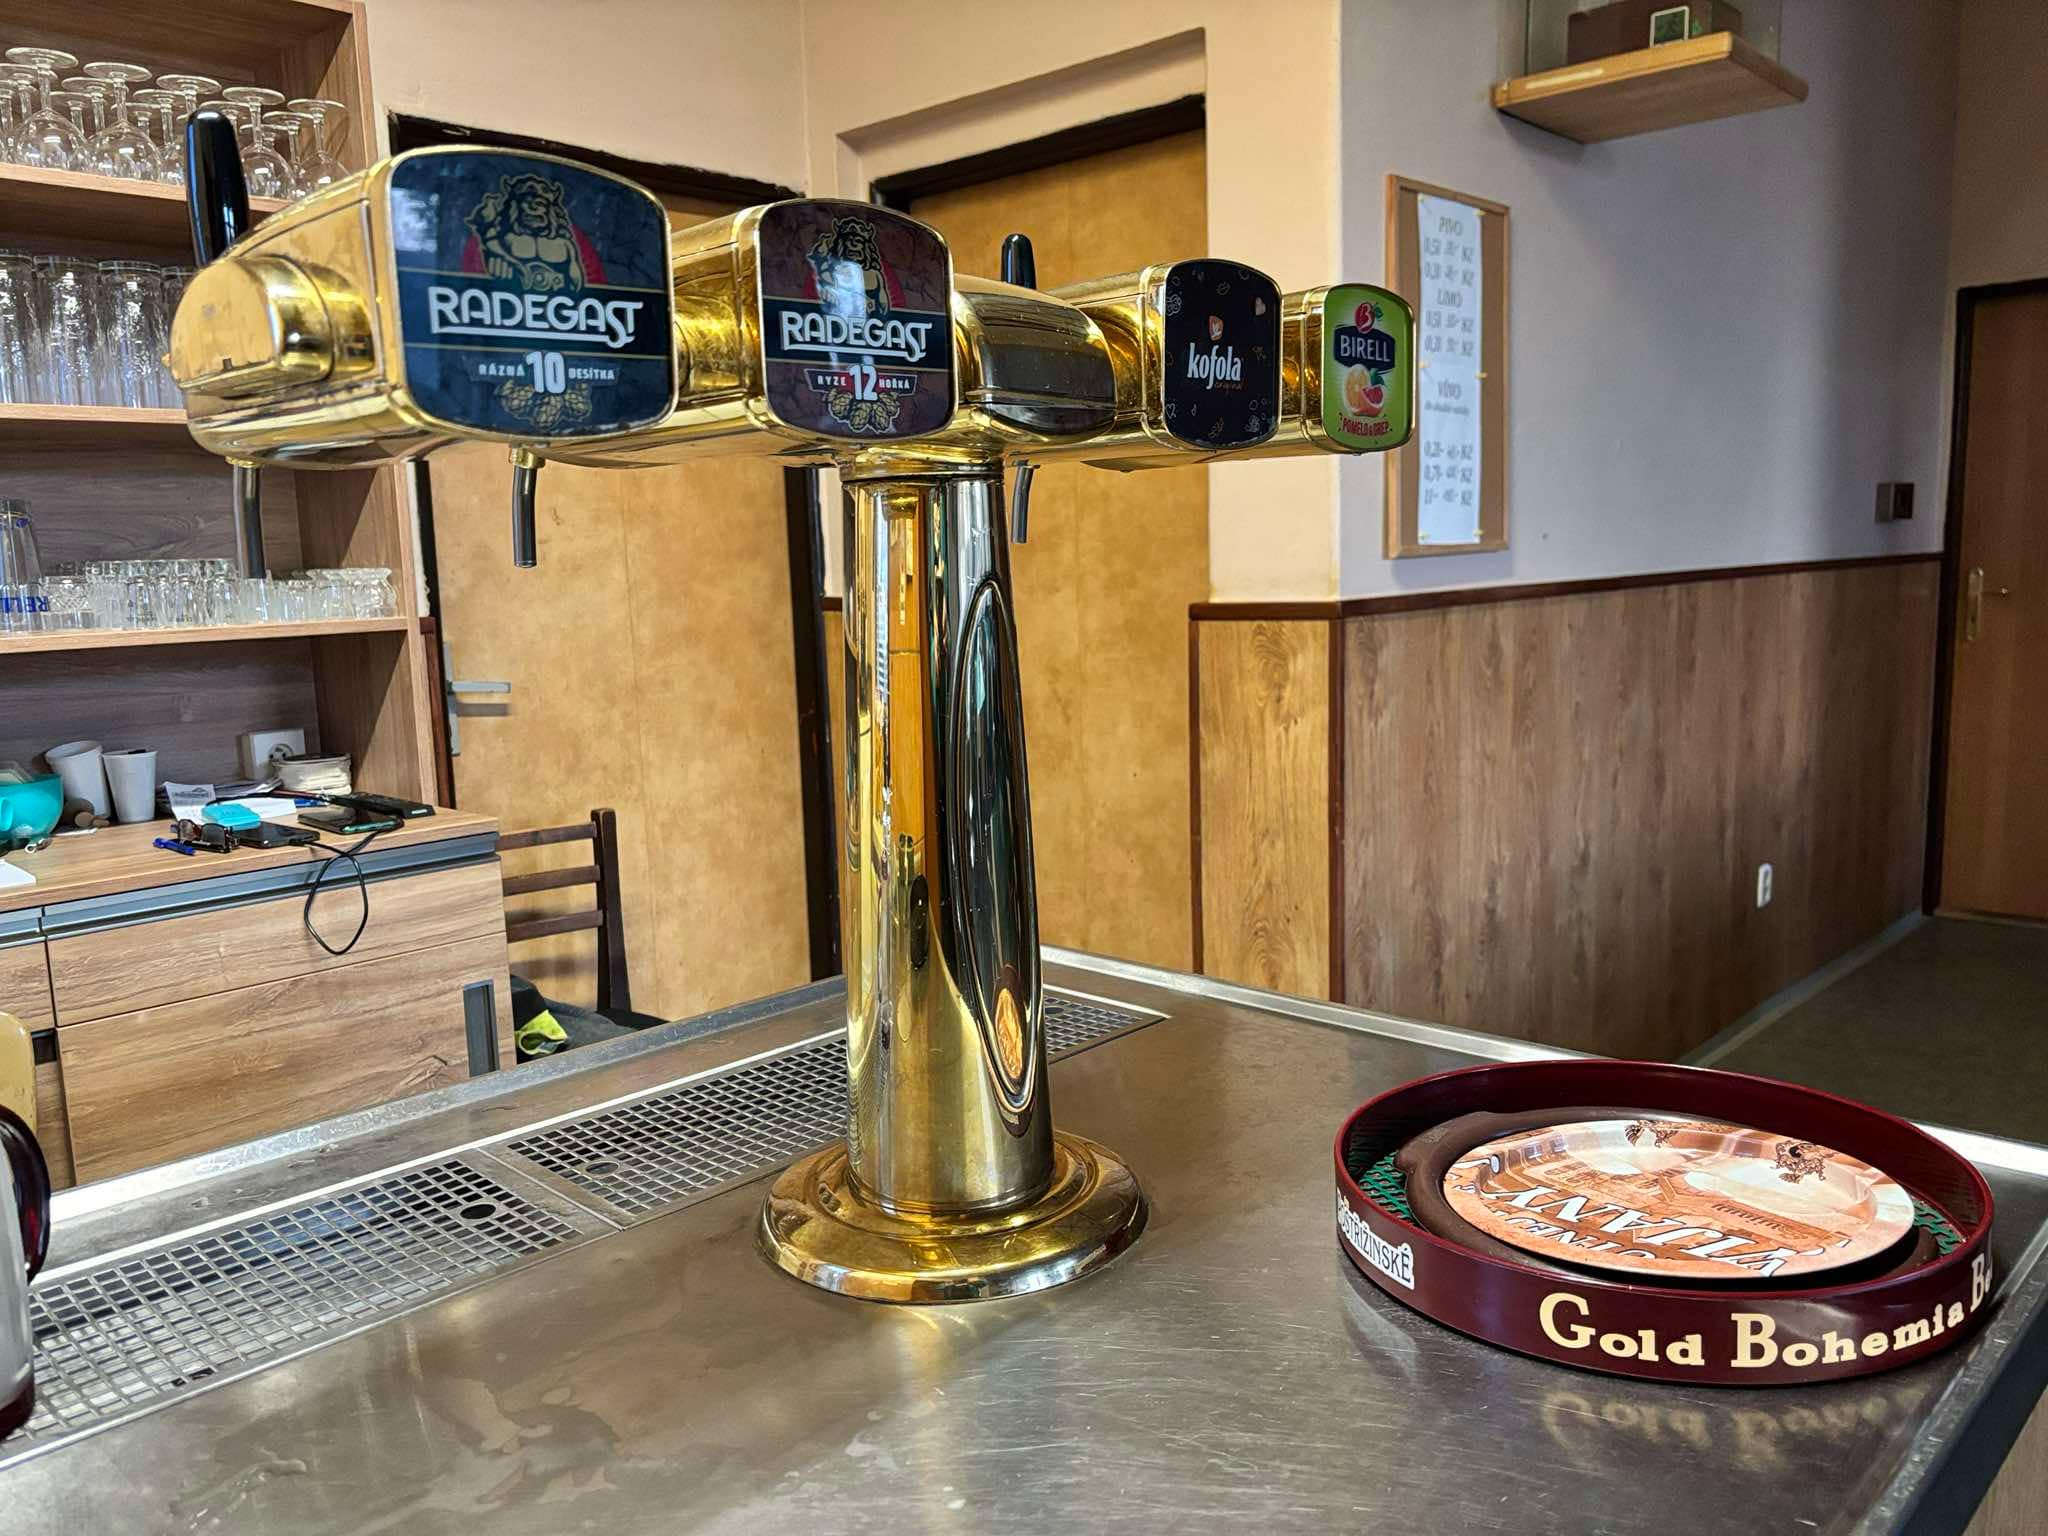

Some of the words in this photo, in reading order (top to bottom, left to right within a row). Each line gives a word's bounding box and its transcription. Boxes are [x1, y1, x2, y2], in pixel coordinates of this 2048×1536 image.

[427, 286, 644, 349] RADEGAST
[778, 310, 933, 363] RADEGAST
[525, 350, 567, 394] 10
[1187, 341, 1242, 390] kofola
[1340, 335, 1391, 362] BIRELL
[848, 364, 879, 401] 12
[1480, 1185, 1828, 1278] VIJANY
[1539, 1292, 1705, 1366] Gold
[1730, 1301, 1965, 1368] Bohemia
